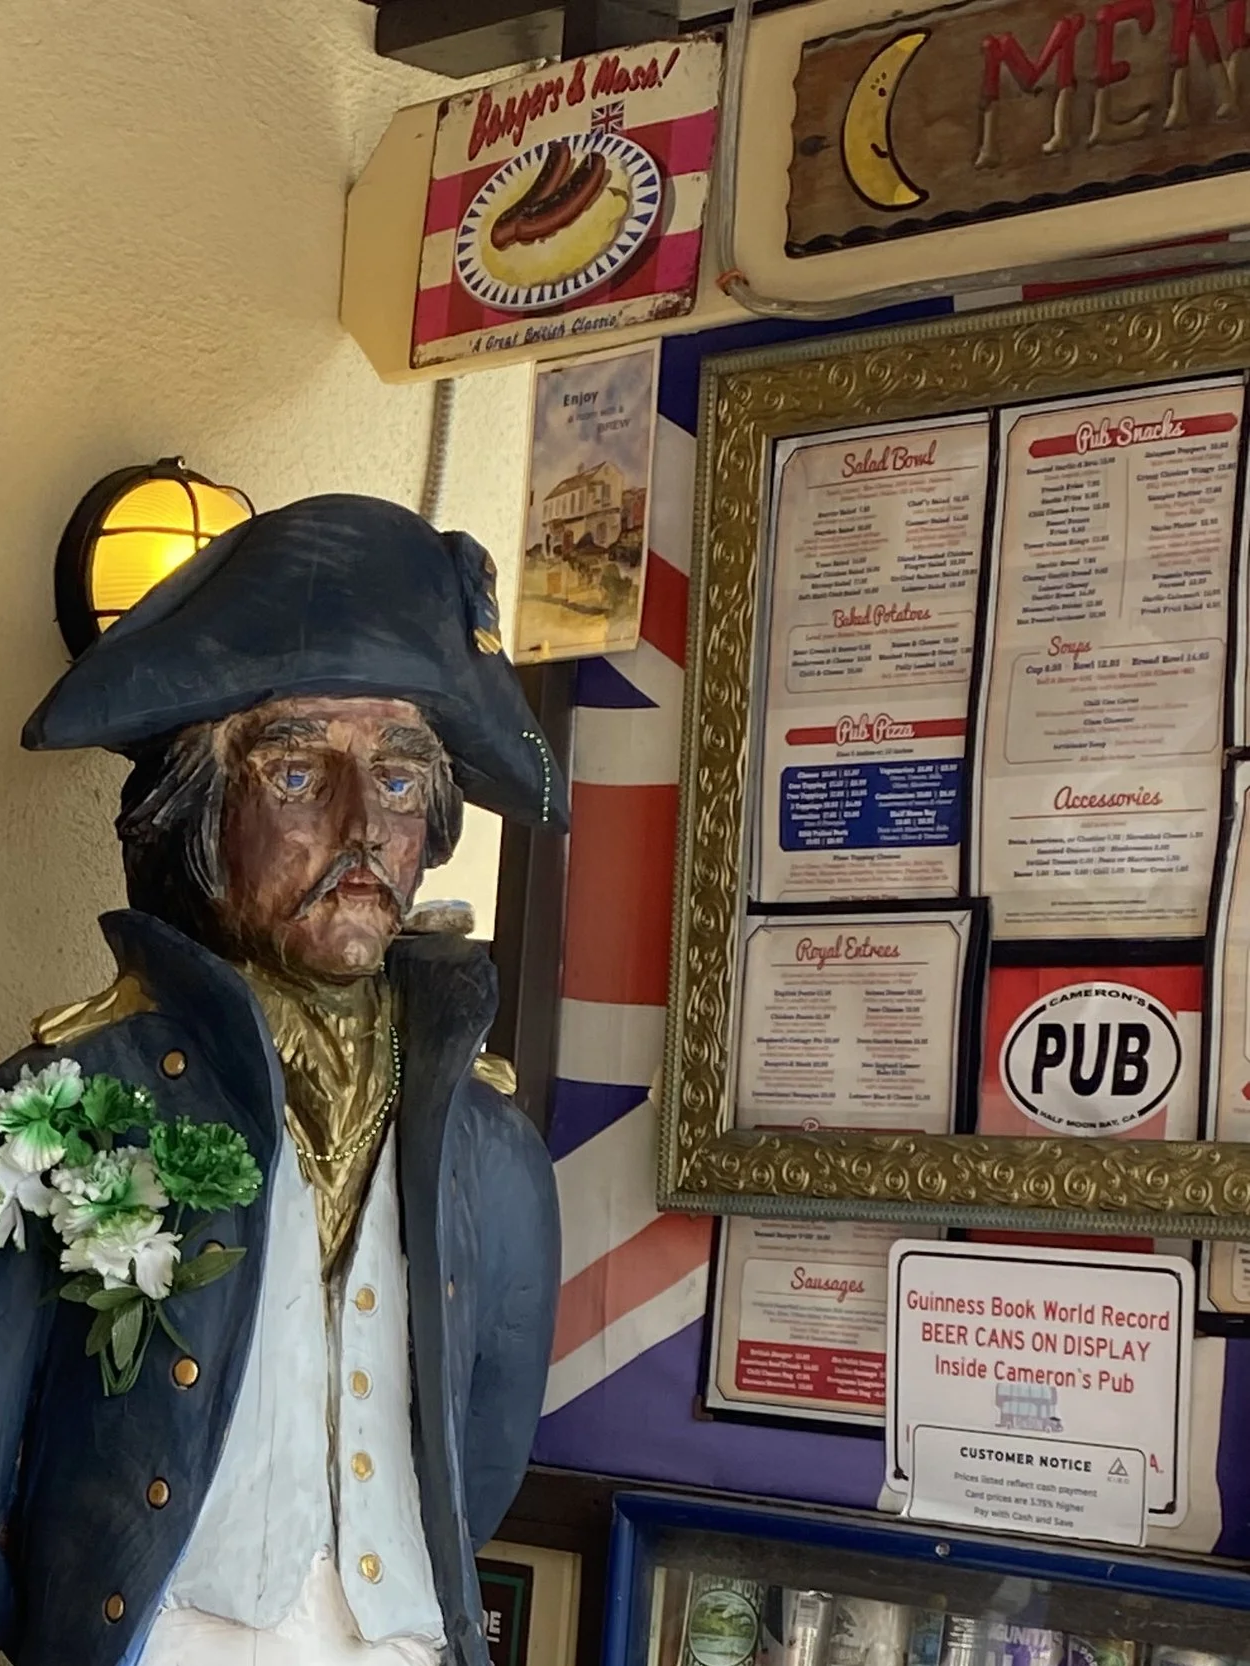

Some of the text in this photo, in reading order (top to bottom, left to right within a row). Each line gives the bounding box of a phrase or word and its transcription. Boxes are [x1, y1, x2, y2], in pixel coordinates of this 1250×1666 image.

[468, 76, 565, 162] Bangers
[485, 333, 519, 351] Great
[524, 322, 567, 346] British
[563, 390, 599, 408] Enjoy
[1075, 408, 1186, 455] Pub Snacks
[842, 439, 939, 479] Salad Bowl
[832, 601, 933, 630] Baked Potatoes
[1046, 635, 1093, 663] Soups
[835, 712, 916, 747] Pub Pizza
[1054, 786, 1164, 811] Accessories
[796, 935, 901, 970] Royal Entrees
[1049, 988, 1147, 1009] CAMERON'S
[1031, 1023, 1152, 1097] PUB
[1039, 1109, 1064, 1125] HALF
[1066, 1118, 1098, 1130] MOON
[1121, 1113, 1138, 1124] CA
[790, 1266, 866, 1304] Sausages
[906, 1290, 1171, 1332] Guinness Book World Record
[921, 1321, 968, 1347] BEER
[974, 1326, 1026, 1352] CANS
[1031, 1331, 1057, 1355] ON
[1063, 1335, 1151, 1363] DISPLAY
[935, 1354, 988, 1381] Inside
[1097, 1370, 1136, 1394] Pub
[960, 1446, 1093, 1474] CUSTOMER NOTICE
[953, 1471, 1099, 1499] Prices listed reflect cash payment
[965, 1489, 986, 1501] Card
[986, 1492, 1013, 1506] prices
[1014, 1496, 1029, 1506] are
[1055, 1500, 1085, 1514] higher
[973, 1506, 1074, 1530] Pay with Cash and Save
